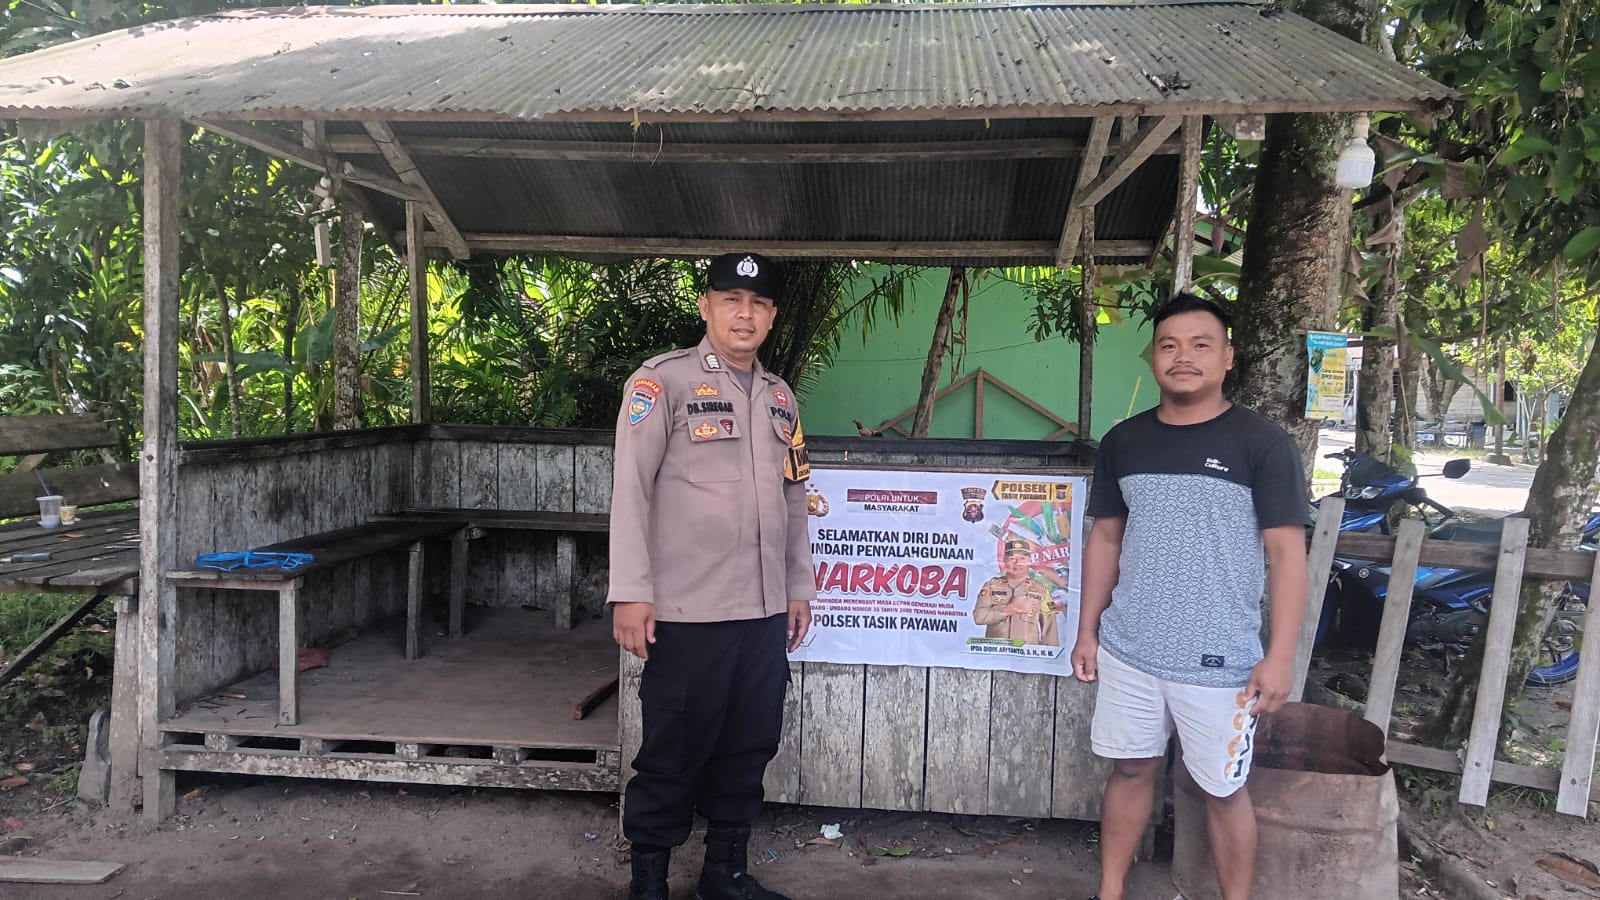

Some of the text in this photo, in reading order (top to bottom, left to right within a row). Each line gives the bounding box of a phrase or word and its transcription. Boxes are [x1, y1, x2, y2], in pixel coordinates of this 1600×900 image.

[1001, 483, 1046, 493] POLSEK
[864, 493, 920, 502] POLRI UNTUK
[864, 504, 920, 512] MASYARAKAT
[817, 528, 958, 546] SELAMATKAN DIRI DAN
[811, 543, 974, 561] INDARI PENYALAHGUNAAN
[812, 561, 968, 599] NARKOBA
[813, 614, 957, 633] POLSEK TASIK PAYAWAN
